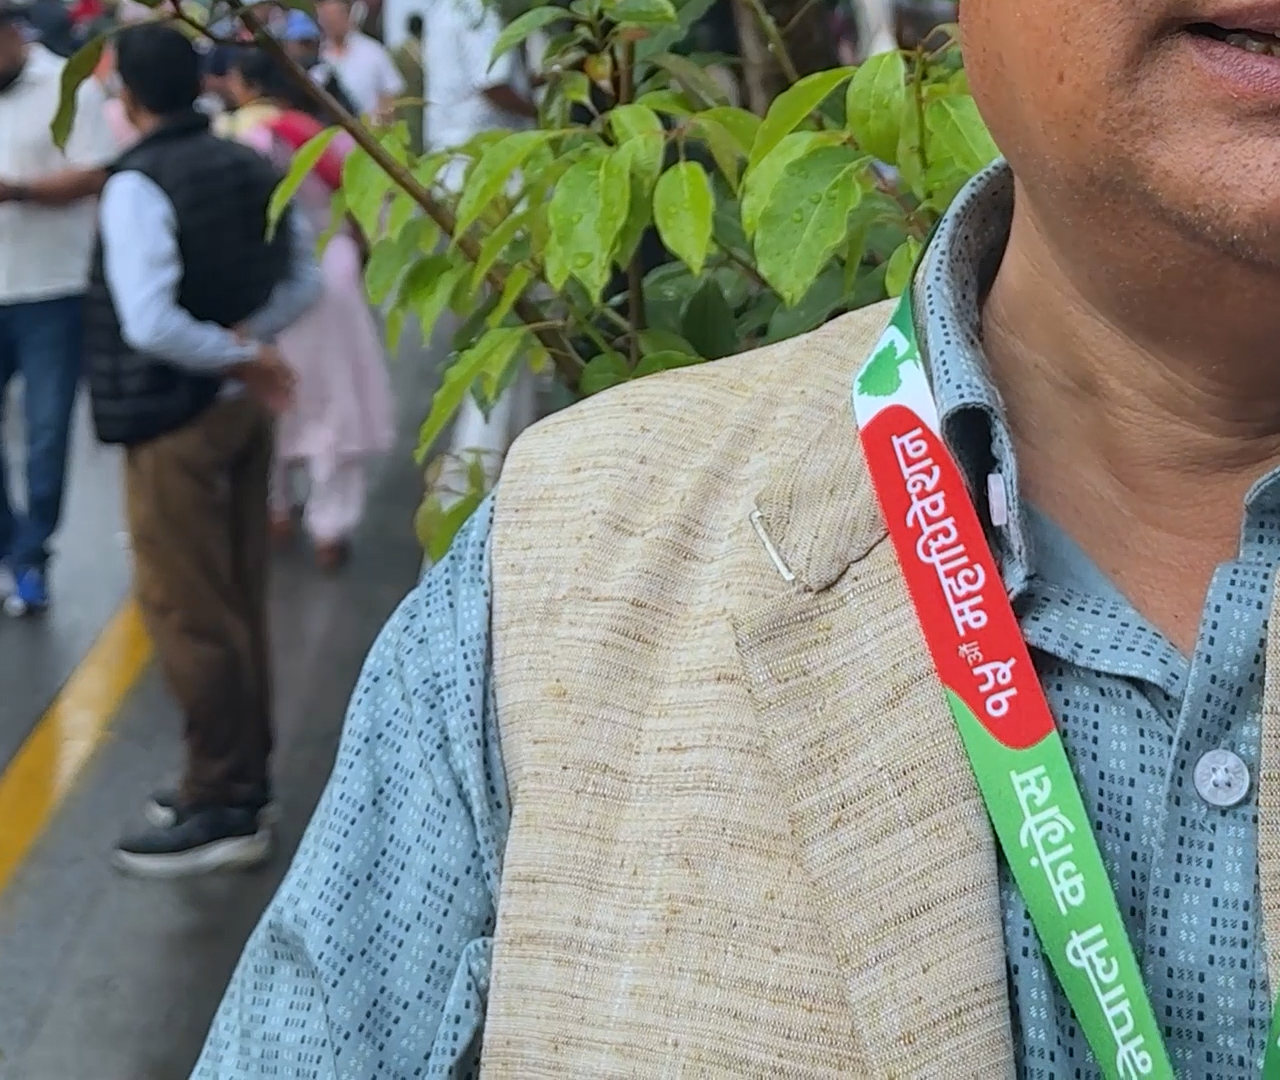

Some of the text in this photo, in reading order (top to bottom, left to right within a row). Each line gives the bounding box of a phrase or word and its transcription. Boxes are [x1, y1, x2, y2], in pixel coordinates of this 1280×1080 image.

[891, 427, 987, 637] महाधिवेशन
[1010, 765, 1086, 916] कांग्रेस
[1066, 924, 1153, 1080] नेपाली
